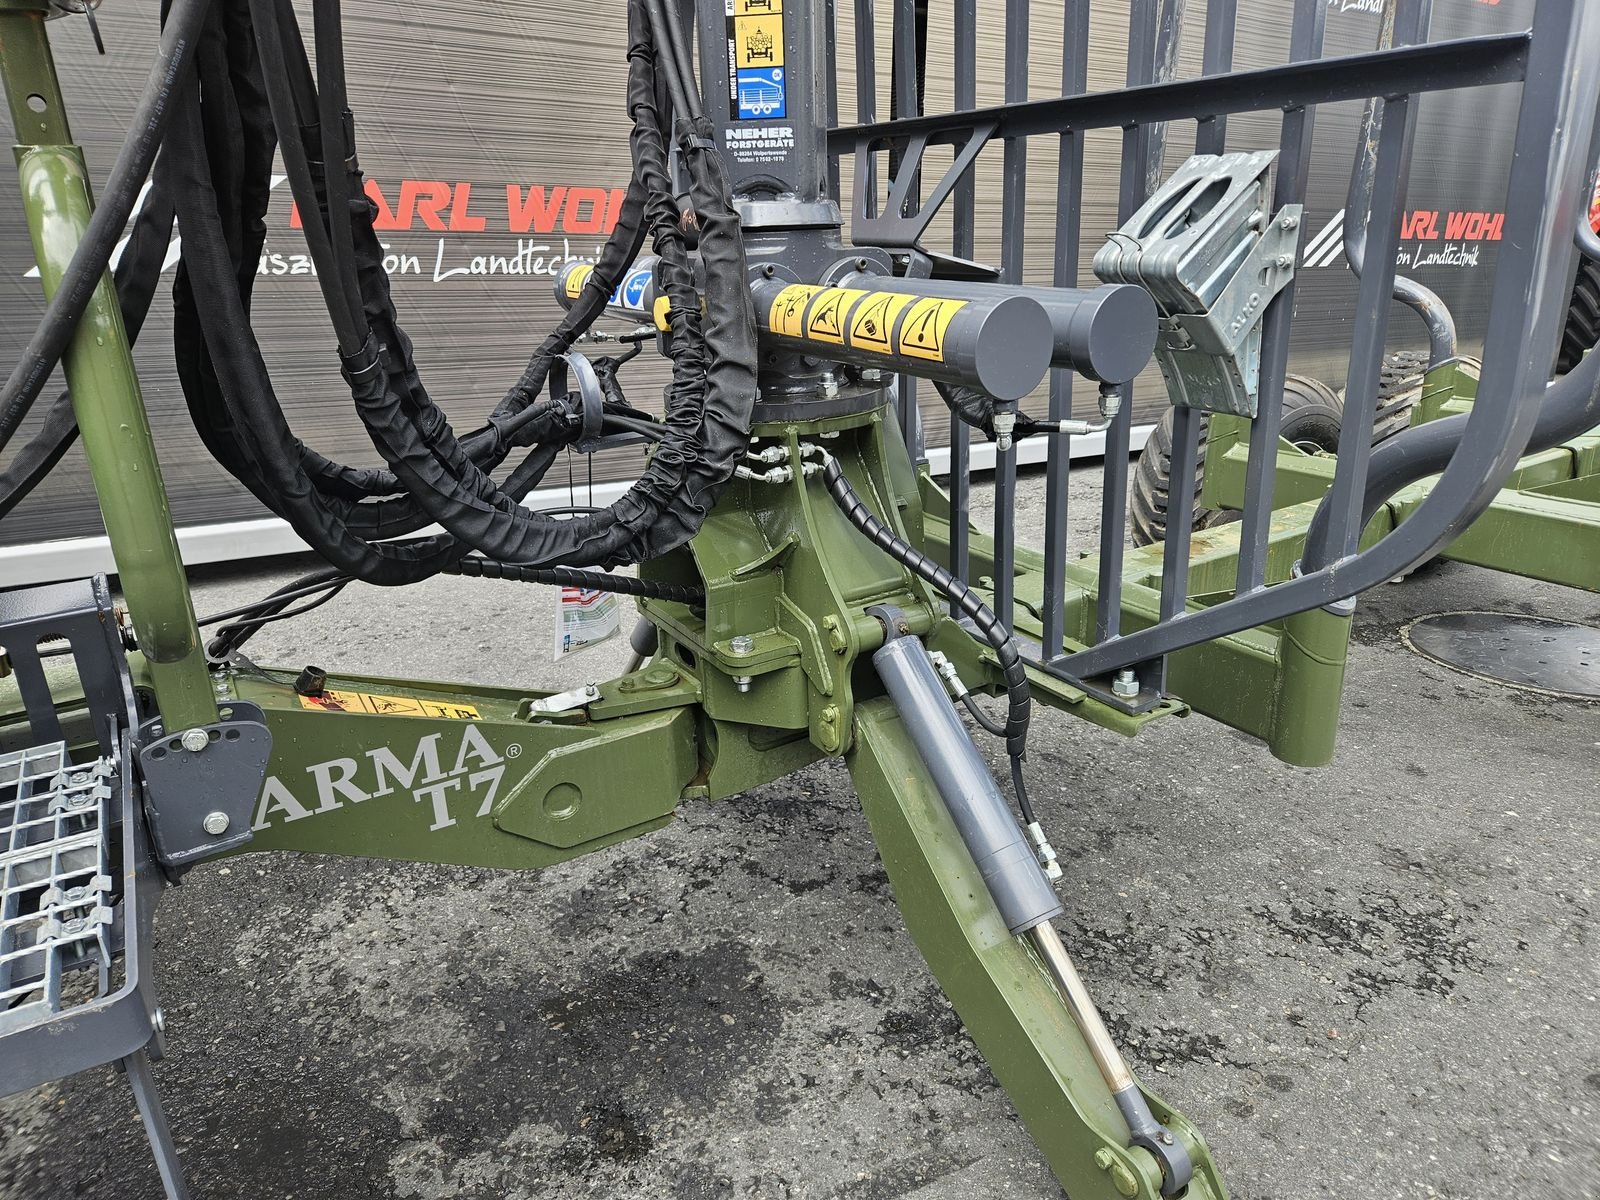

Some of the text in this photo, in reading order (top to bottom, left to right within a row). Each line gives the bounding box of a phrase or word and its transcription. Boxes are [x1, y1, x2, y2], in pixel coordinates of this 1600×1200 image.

[728, 38, 736, 77] TRANSPORT
[725, 127, 794, 140] NEHER
[726, 138, 795, 149] FORSTGERÄTE
[290, 179, 487, 232] ARL
[1412, 243, 1479, 269] Landtechnik
[251, 723, 504, 832] ARMA
[412, 764, 506, 832] T7
